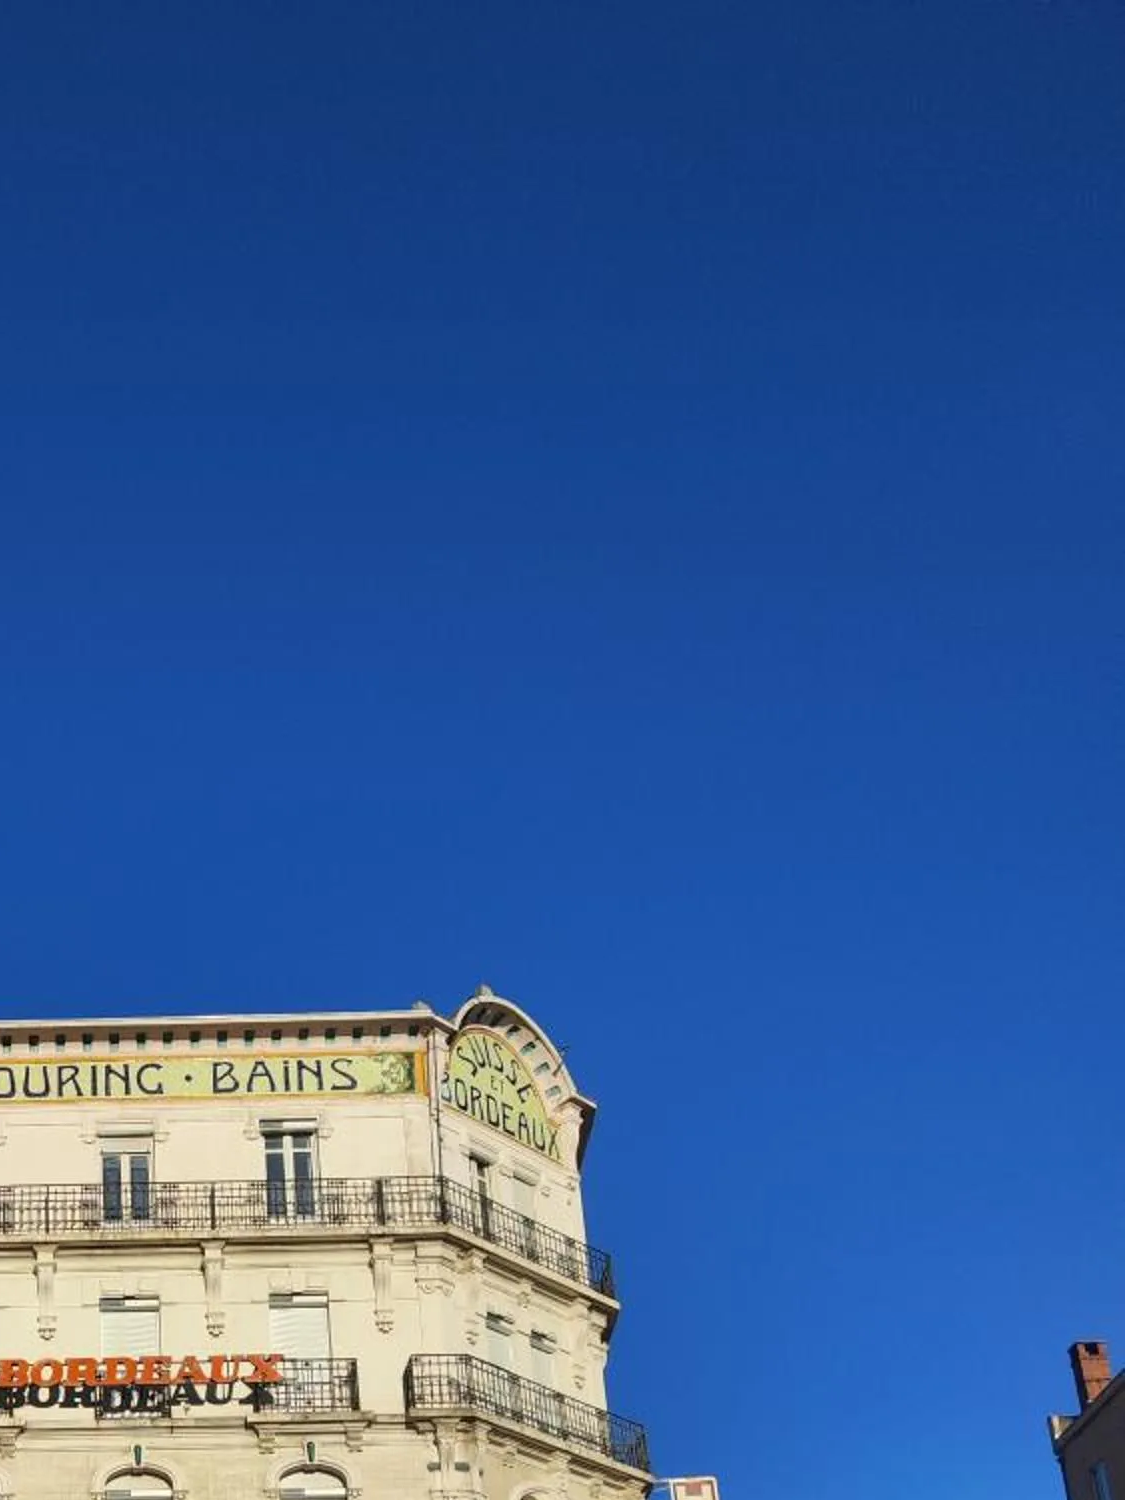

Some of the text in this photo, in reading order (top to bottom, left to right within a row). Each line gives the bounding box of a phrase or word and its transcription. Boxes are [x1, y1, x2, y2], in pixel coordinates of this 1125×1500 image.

[456, 1036, 532, 1104] SUISSE
[491, 1075, 504, 1095] ET
[440, 1071, 561, 1160] BORDEAUX
